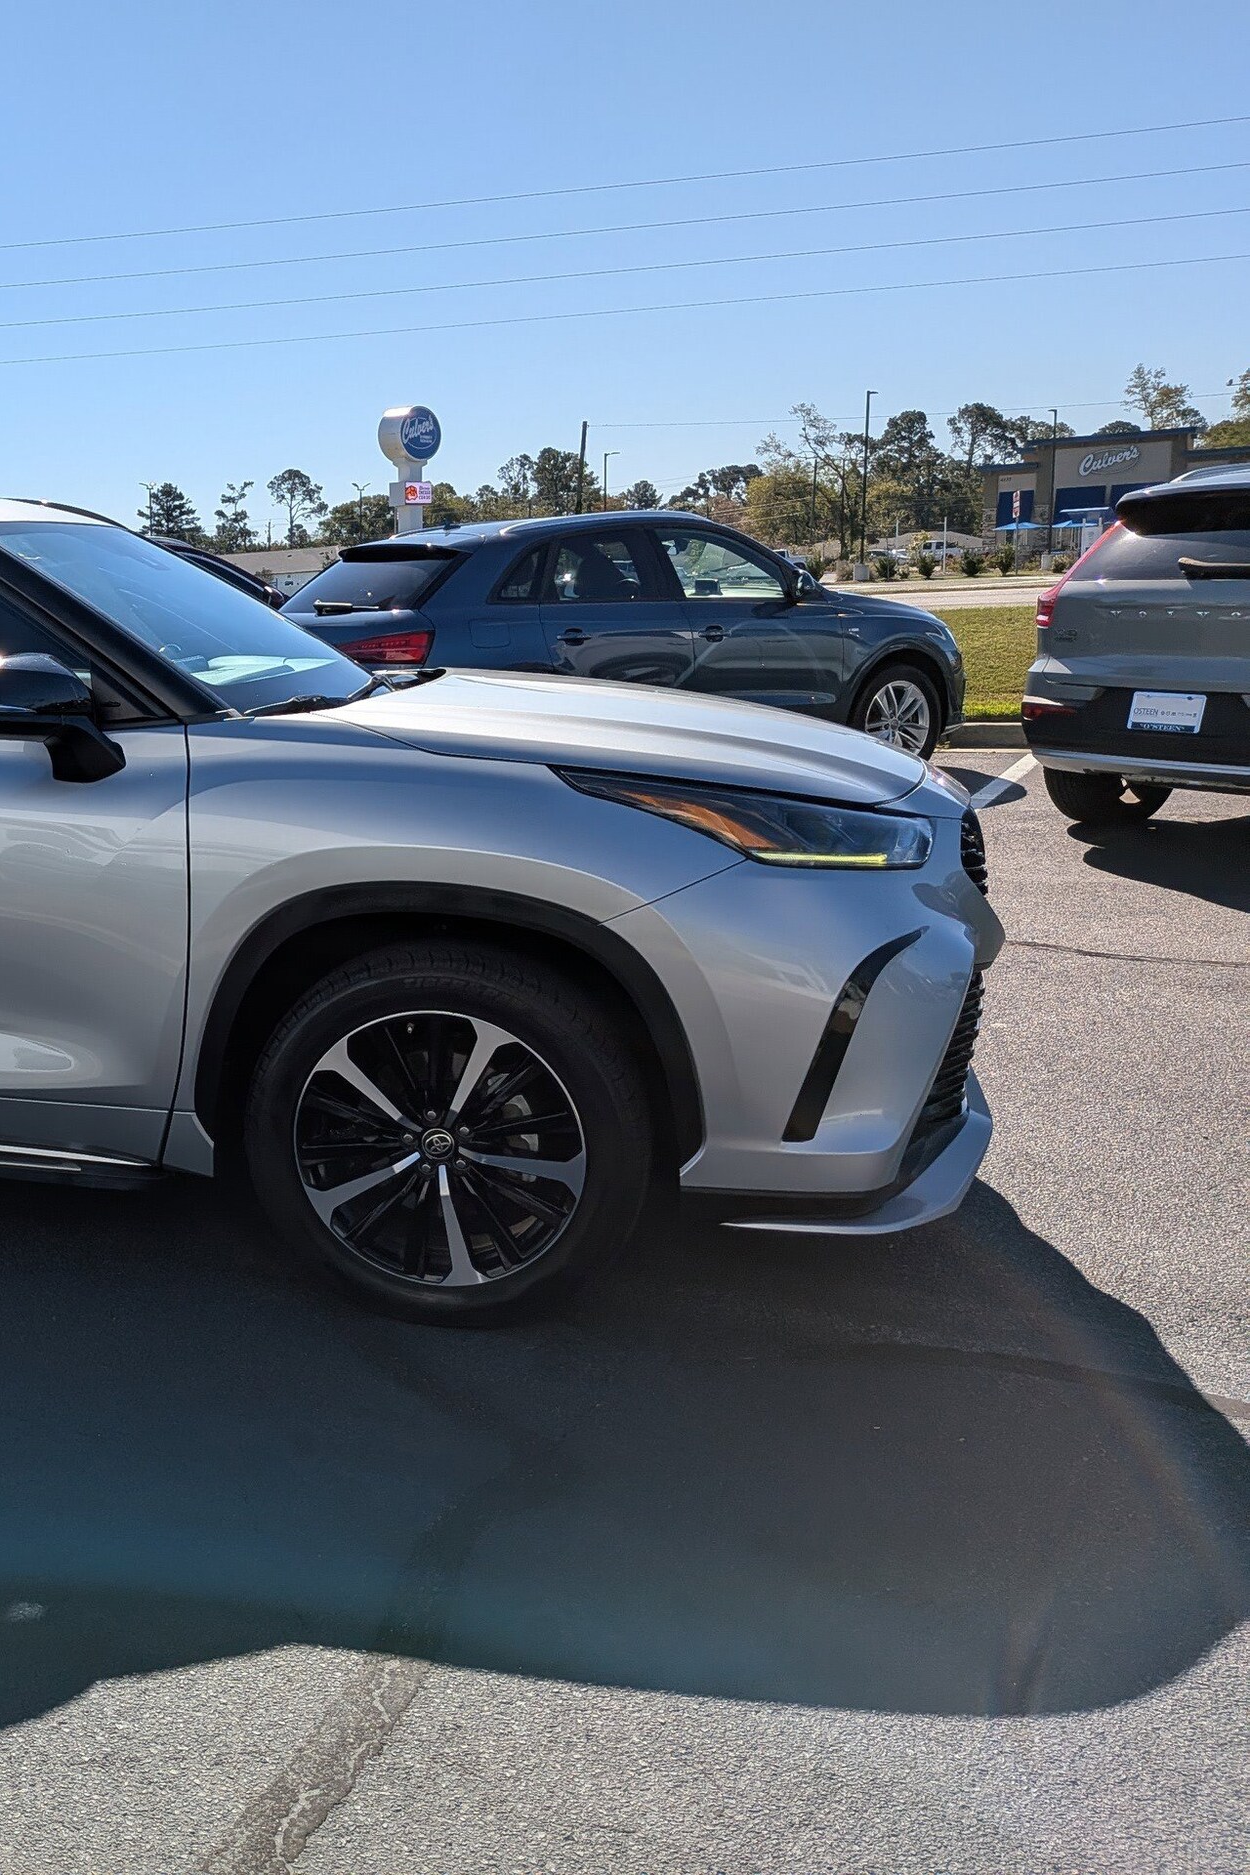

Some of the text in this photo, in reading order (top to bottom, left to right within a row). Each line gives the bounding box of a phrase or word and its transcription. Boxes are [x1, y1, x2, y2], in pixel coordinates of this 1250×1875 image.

[402, 414, 435, 444] Culver's
[1078, 445, 1140, 476] Culver's
[1133, 706, 1159, 717] OSTEEN
